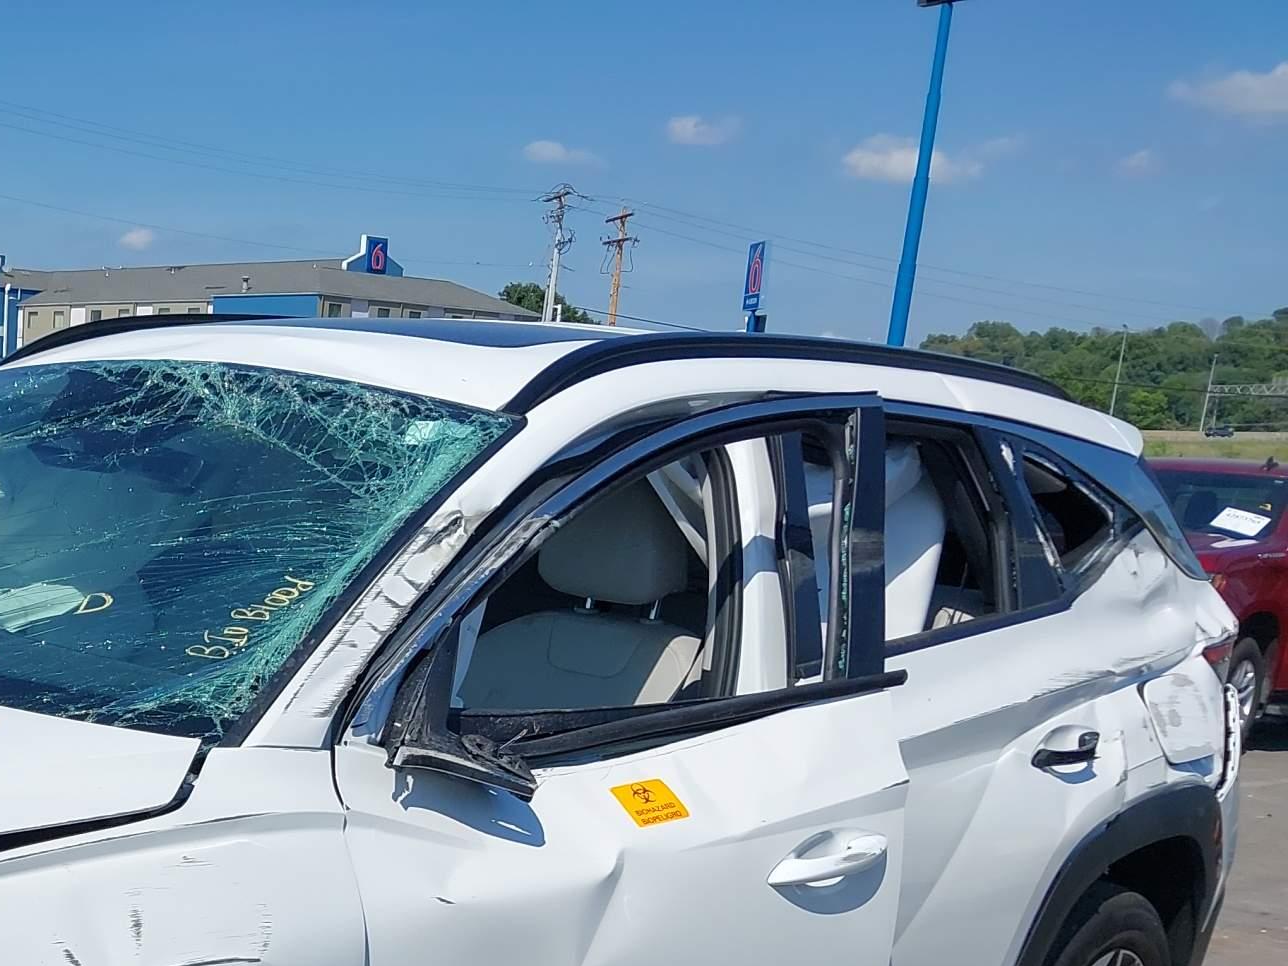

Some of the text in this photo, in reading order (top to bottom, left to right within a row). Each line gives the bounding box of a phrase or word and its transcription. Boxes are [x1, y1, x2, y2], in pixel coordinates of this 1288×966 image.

[371, 243, 385, 271] 6
[748, 243, 763, 294] 6
[634, 802, 676, 817] BIOHAZARD
